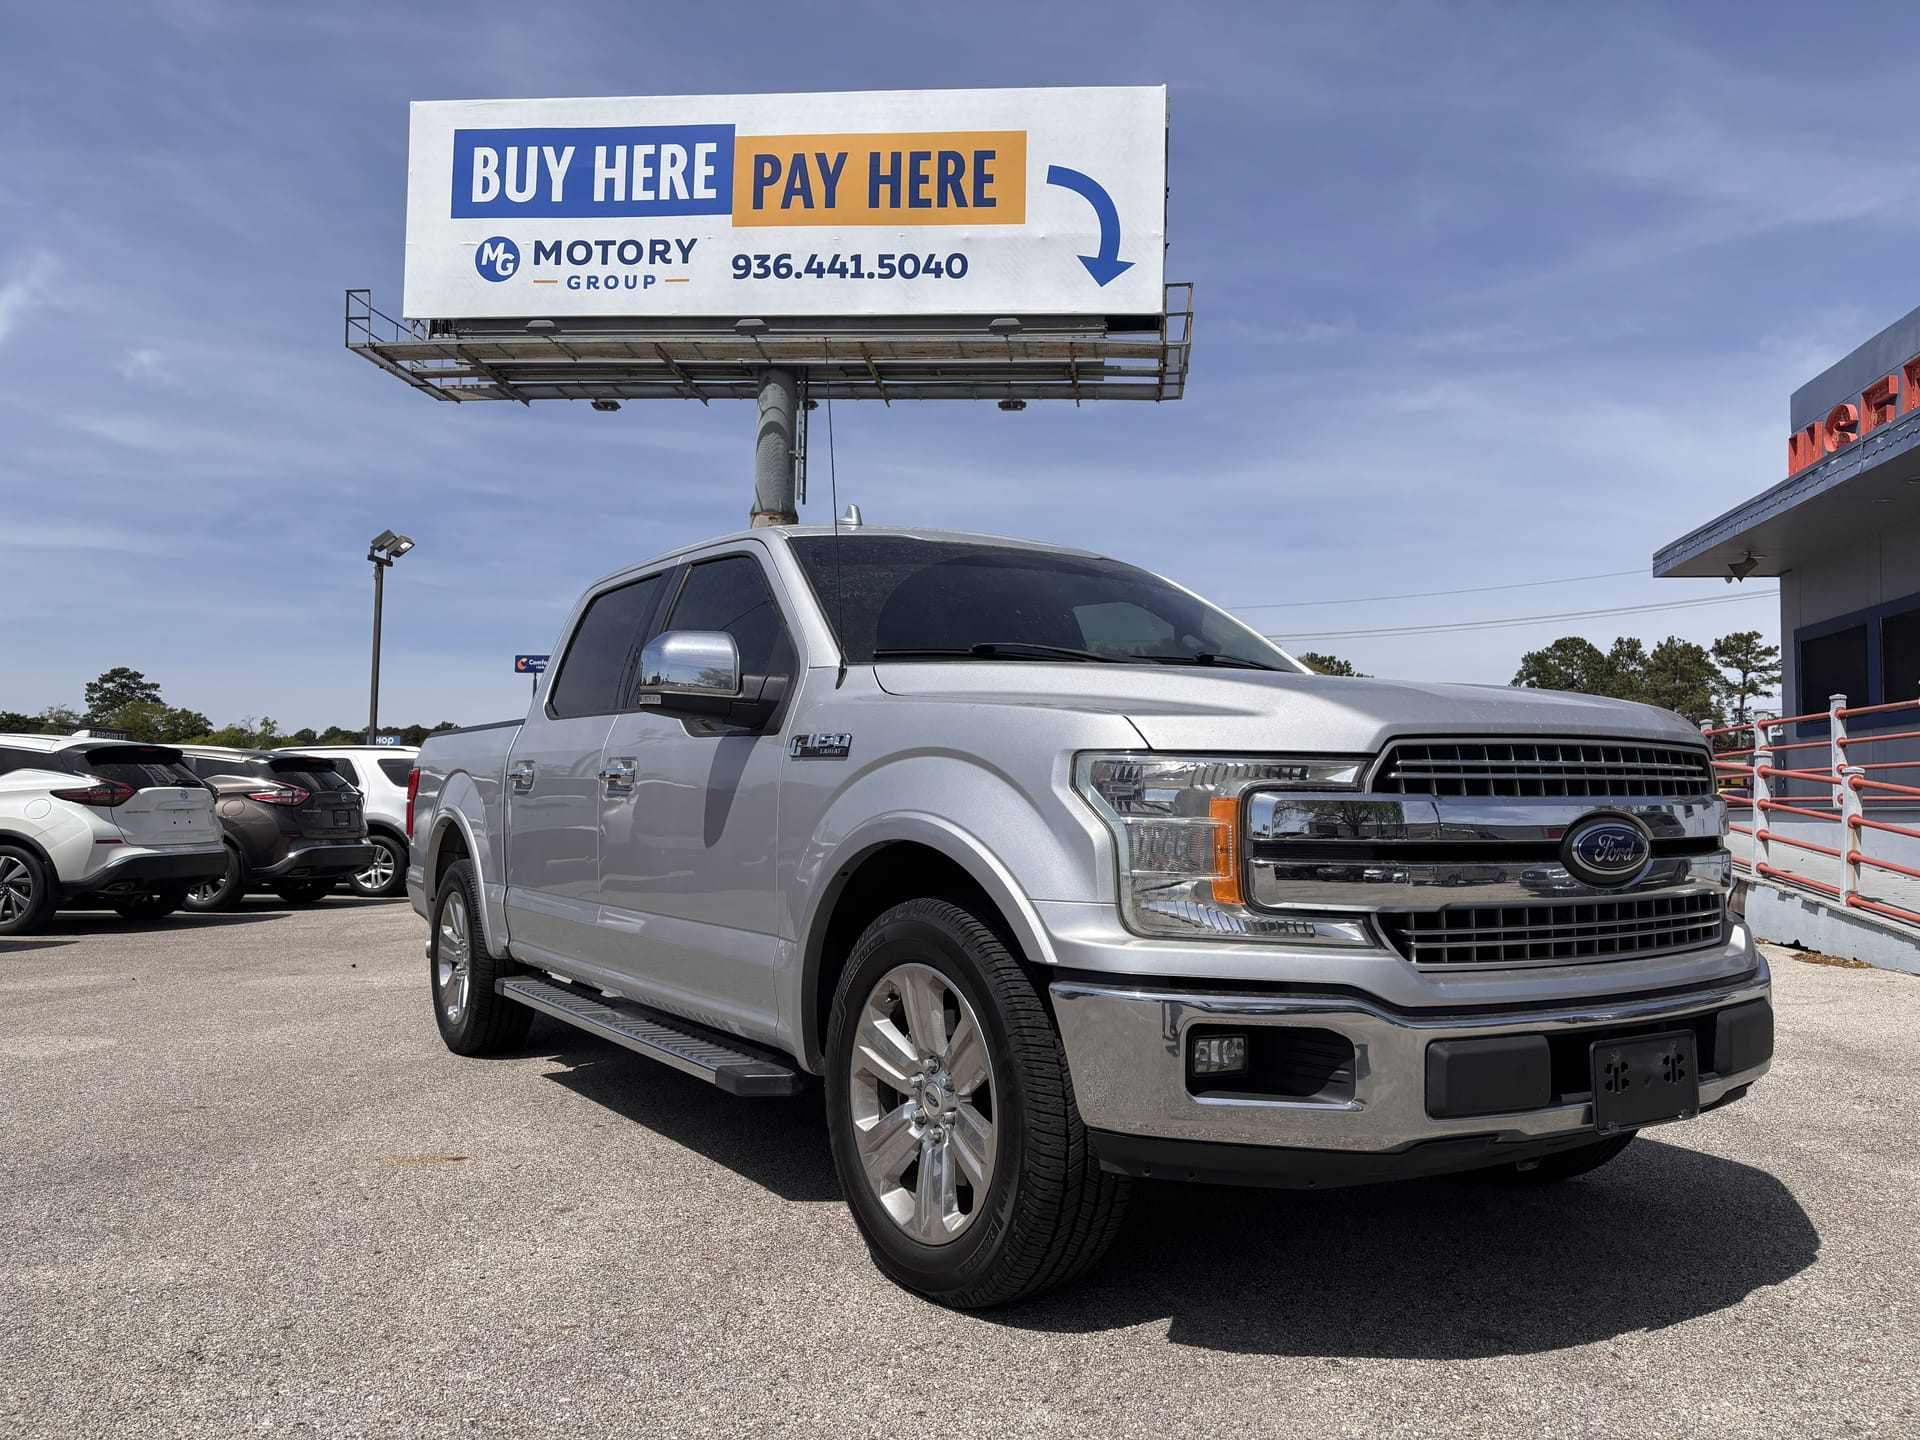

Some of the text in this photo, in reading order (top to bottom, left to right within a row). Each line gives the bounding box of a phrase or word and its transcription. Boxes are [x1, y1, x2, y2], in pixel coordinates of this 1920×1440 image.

[472, 142, 717, 203] BUY HERE
[752, 149, 997, 210] PAY HERE
[481, 242, 516, 276] MG
[533, 238, 698, 266] MOTORY
[731, 252, 969, 280] 936.441.5040
[567, 274, 657, 290] GROUP
[1594, 834, 1636, 862] Ford
